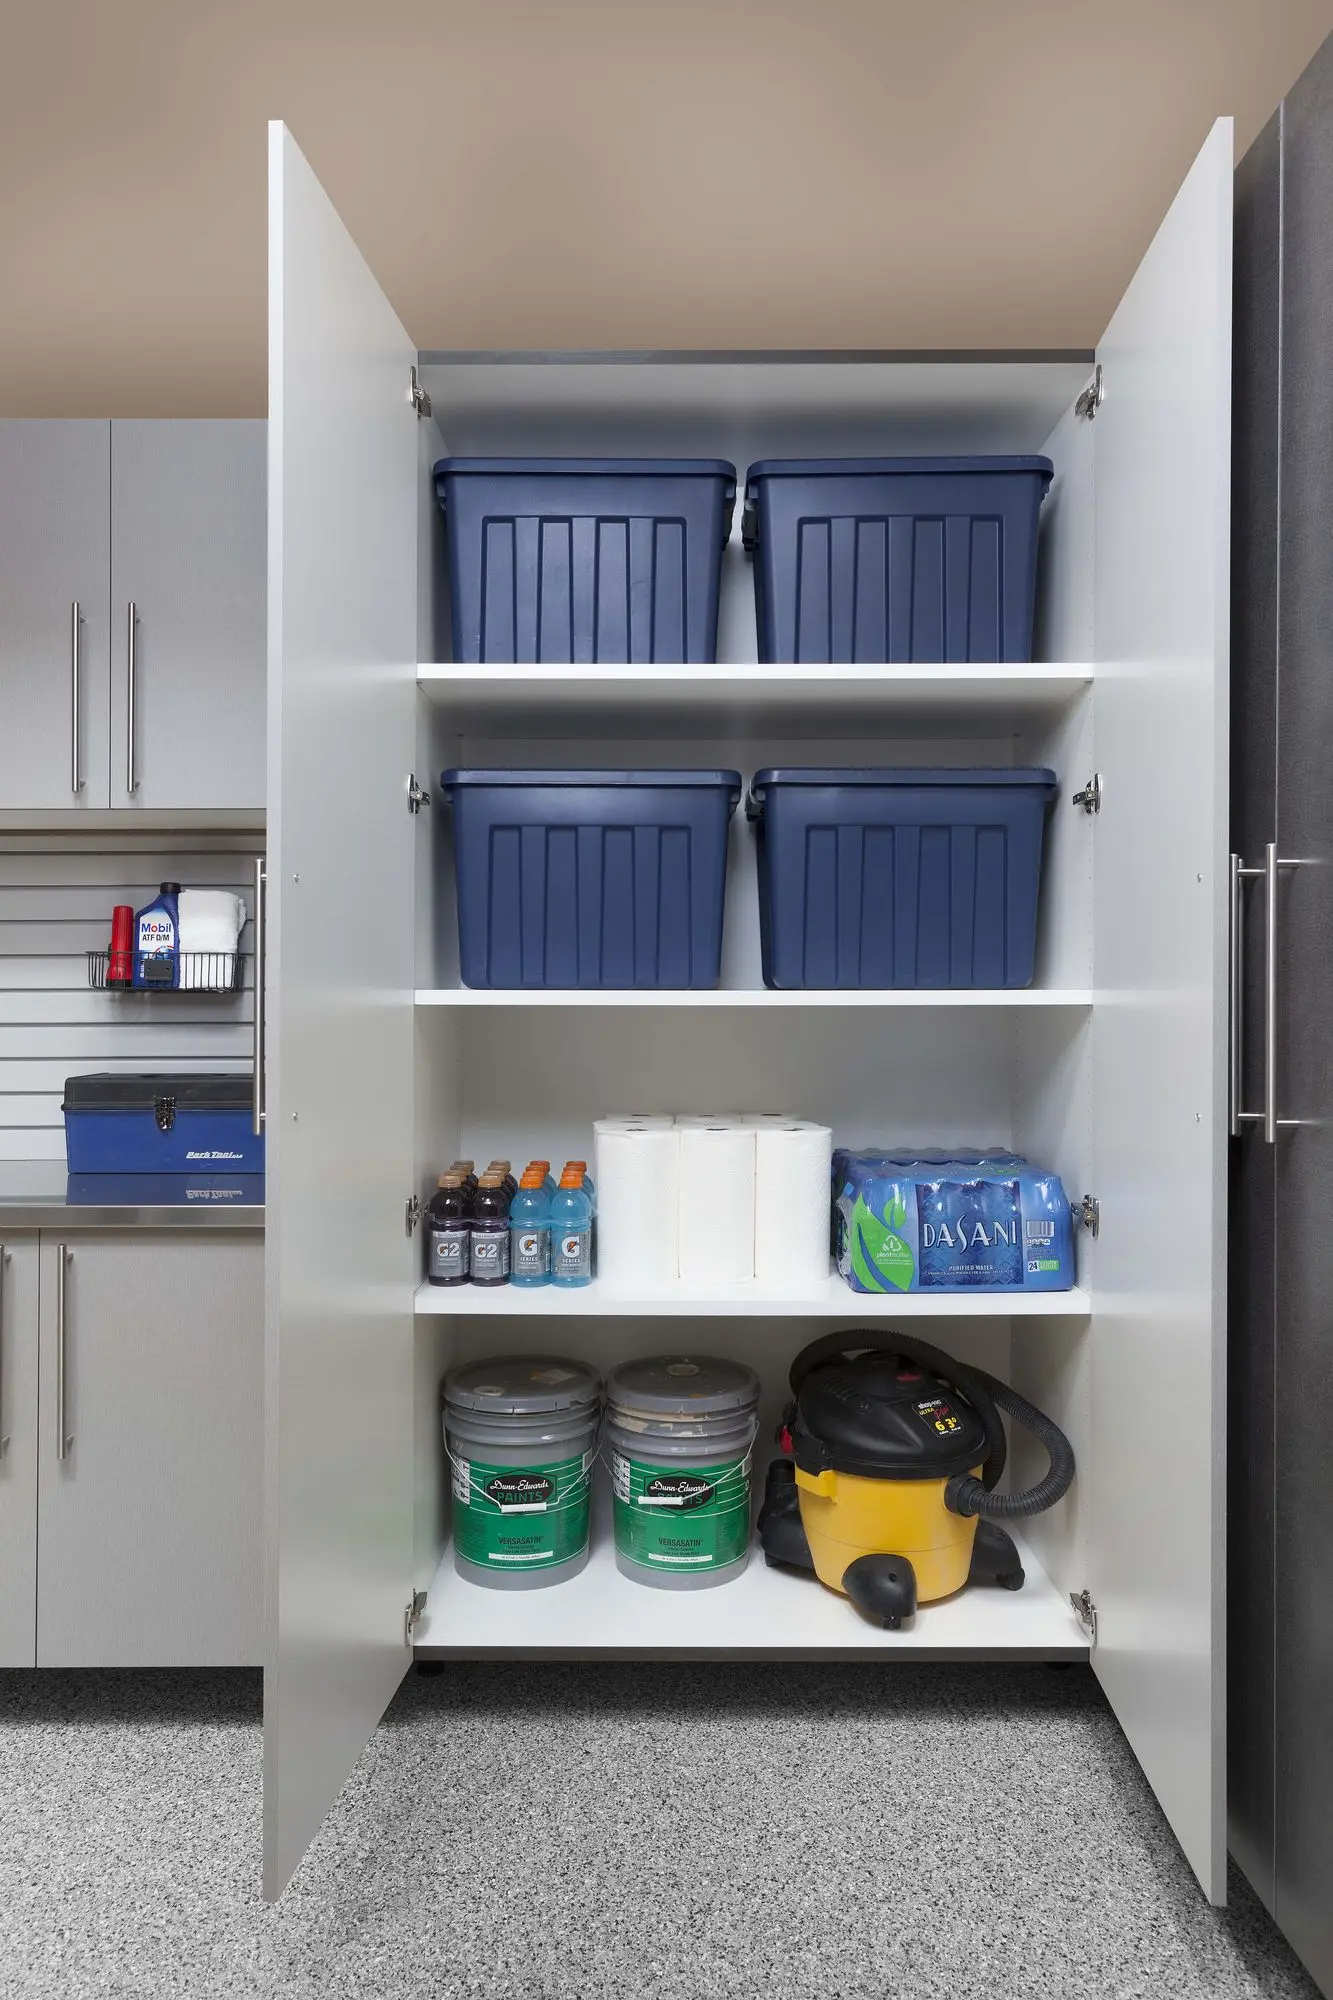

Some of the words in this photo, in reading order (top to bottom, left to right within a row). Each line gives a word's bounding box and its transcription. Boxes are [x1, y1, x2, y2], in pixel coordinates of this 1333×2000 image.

[141, 922, 171, 933] Mobil
[923, 1214, 1016, 1254] DASANI
[437, 1242, 460, 1257] G2
[475, 1243, 498, 1258] G2
[519, 1234, 538, 1256] G
[561, 1236, 580, 1258] G
[1028, 1262, 1038, 1271] 24
[935, 1420, 946, 1431] 6
[490, 1479, 550, 1491] Dunn-Edwards
[650, 1480, 710, 1493] Dunn-Edwards
[497, 1491, 543, 1503] PAINTS
